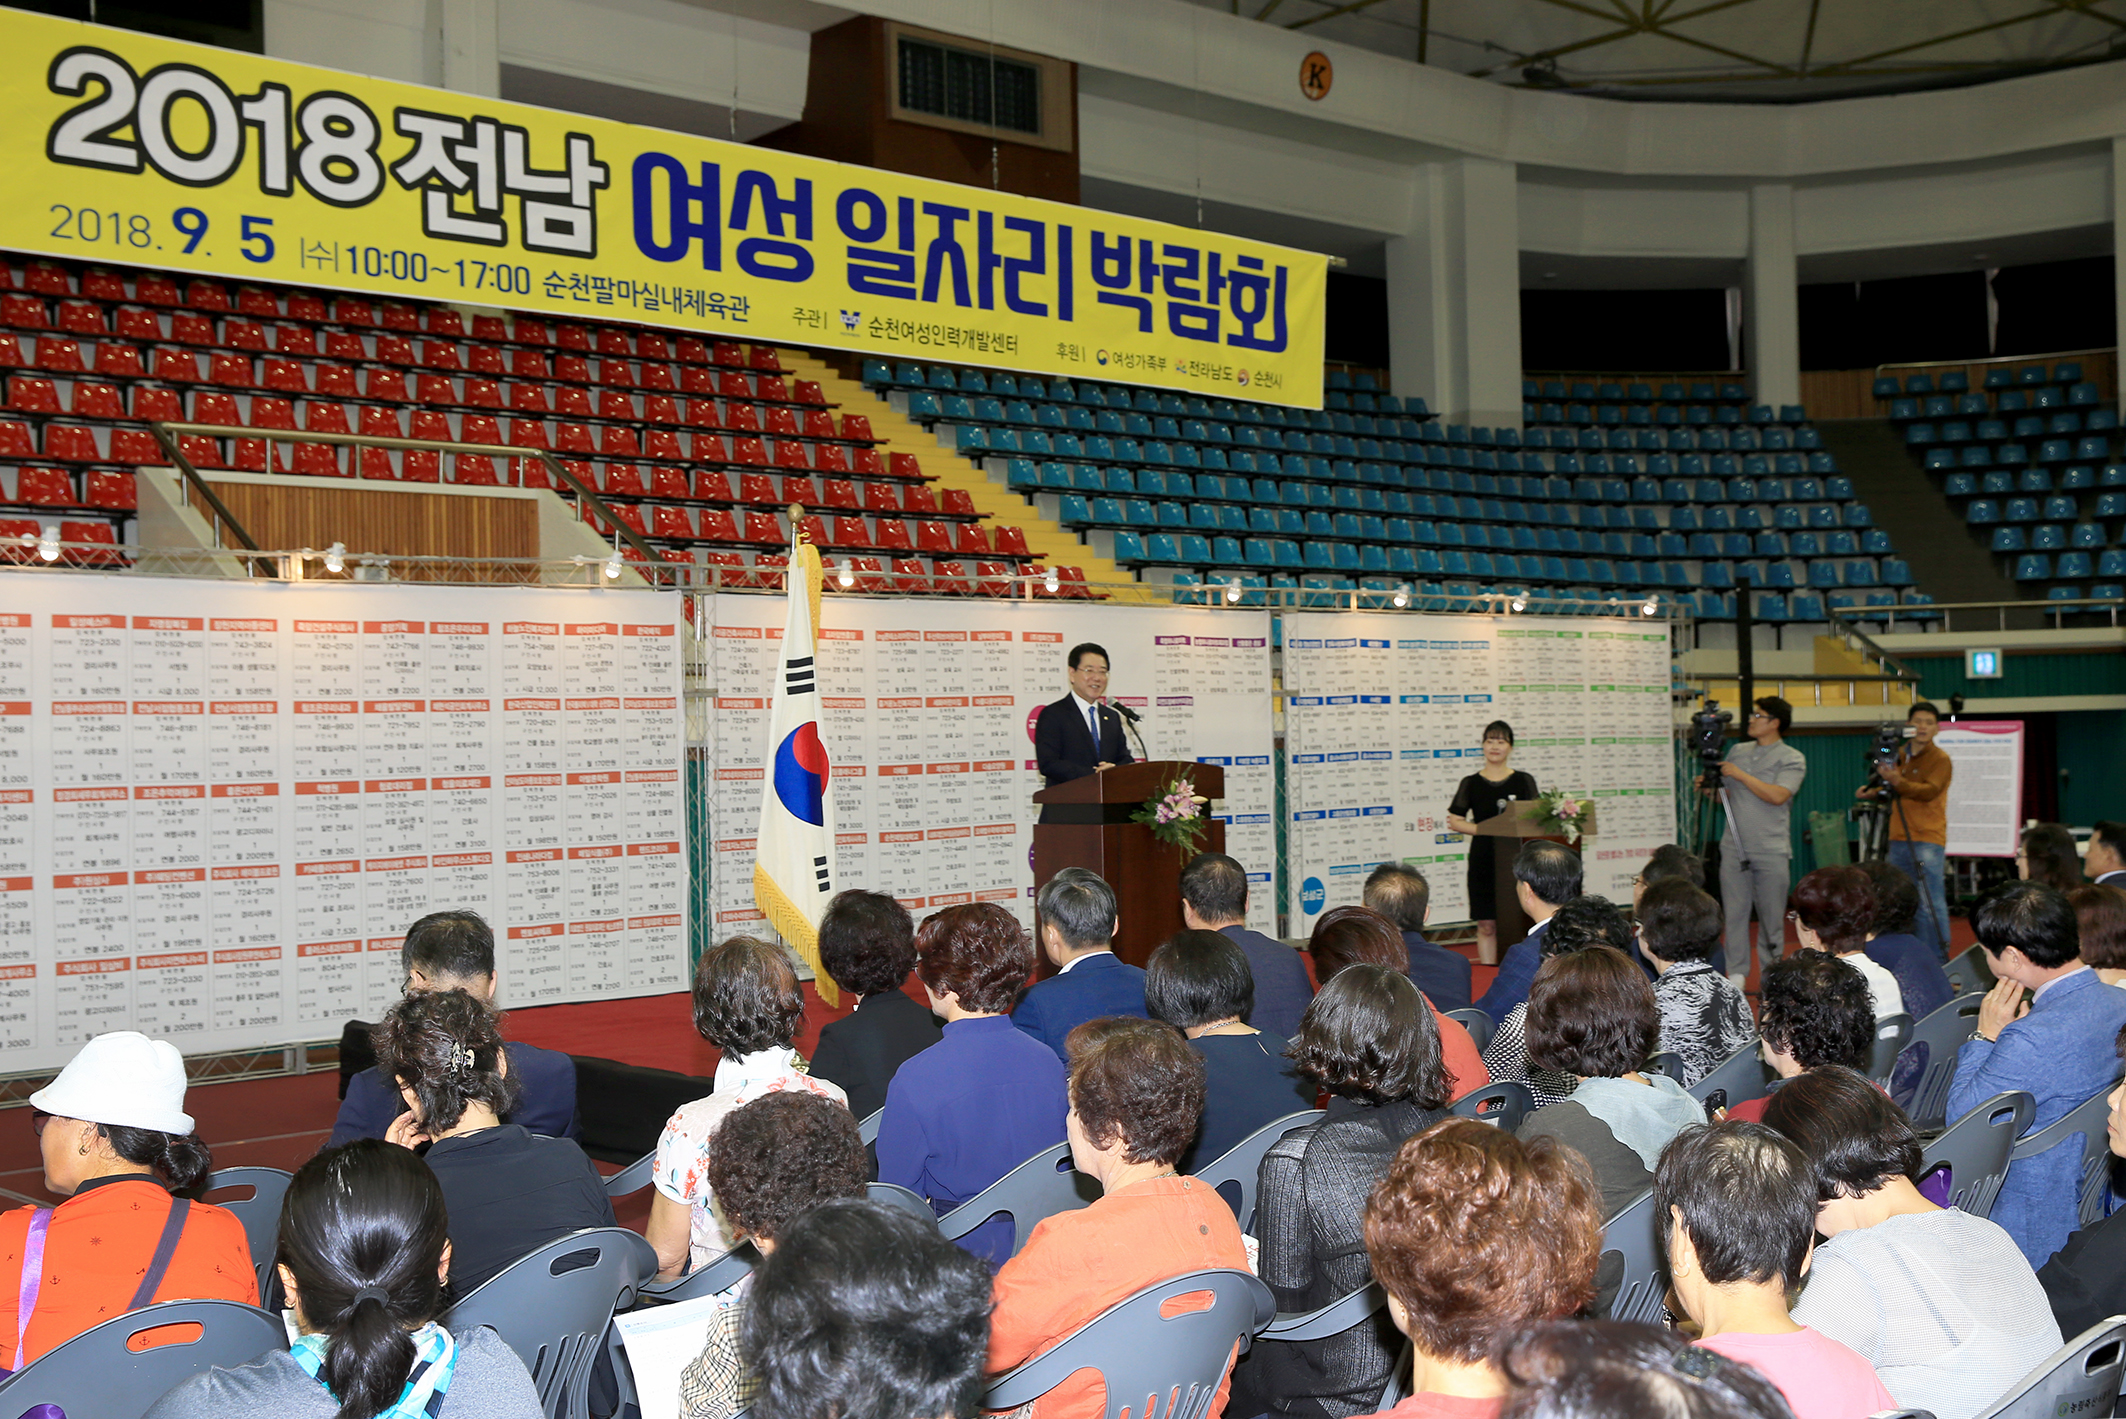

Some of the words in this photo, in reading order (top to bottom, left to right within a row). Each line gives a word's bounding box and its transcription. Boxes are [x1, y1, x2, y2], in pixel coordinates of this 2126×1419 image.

[1308, 62, 1326, 90] K
[240, 214, 275, 263] 5
[345, 245, 531, 295] 10:00~17:00
[543, 270, 750, 322] 순천팔마실내체육관
[632, 151, 813, 283] 여성
[836, 188, 1073, 322] 일자리
[1090, 230, 1287, 353] 박람회
[869, 316, 1018, 355] 순천여성인력개발센터
[1113, 351, 1167, 372] 여성가족부
[1189, 360, 1233, 381] 전라남도
[1254, 369, 1282, 389] 순천시
